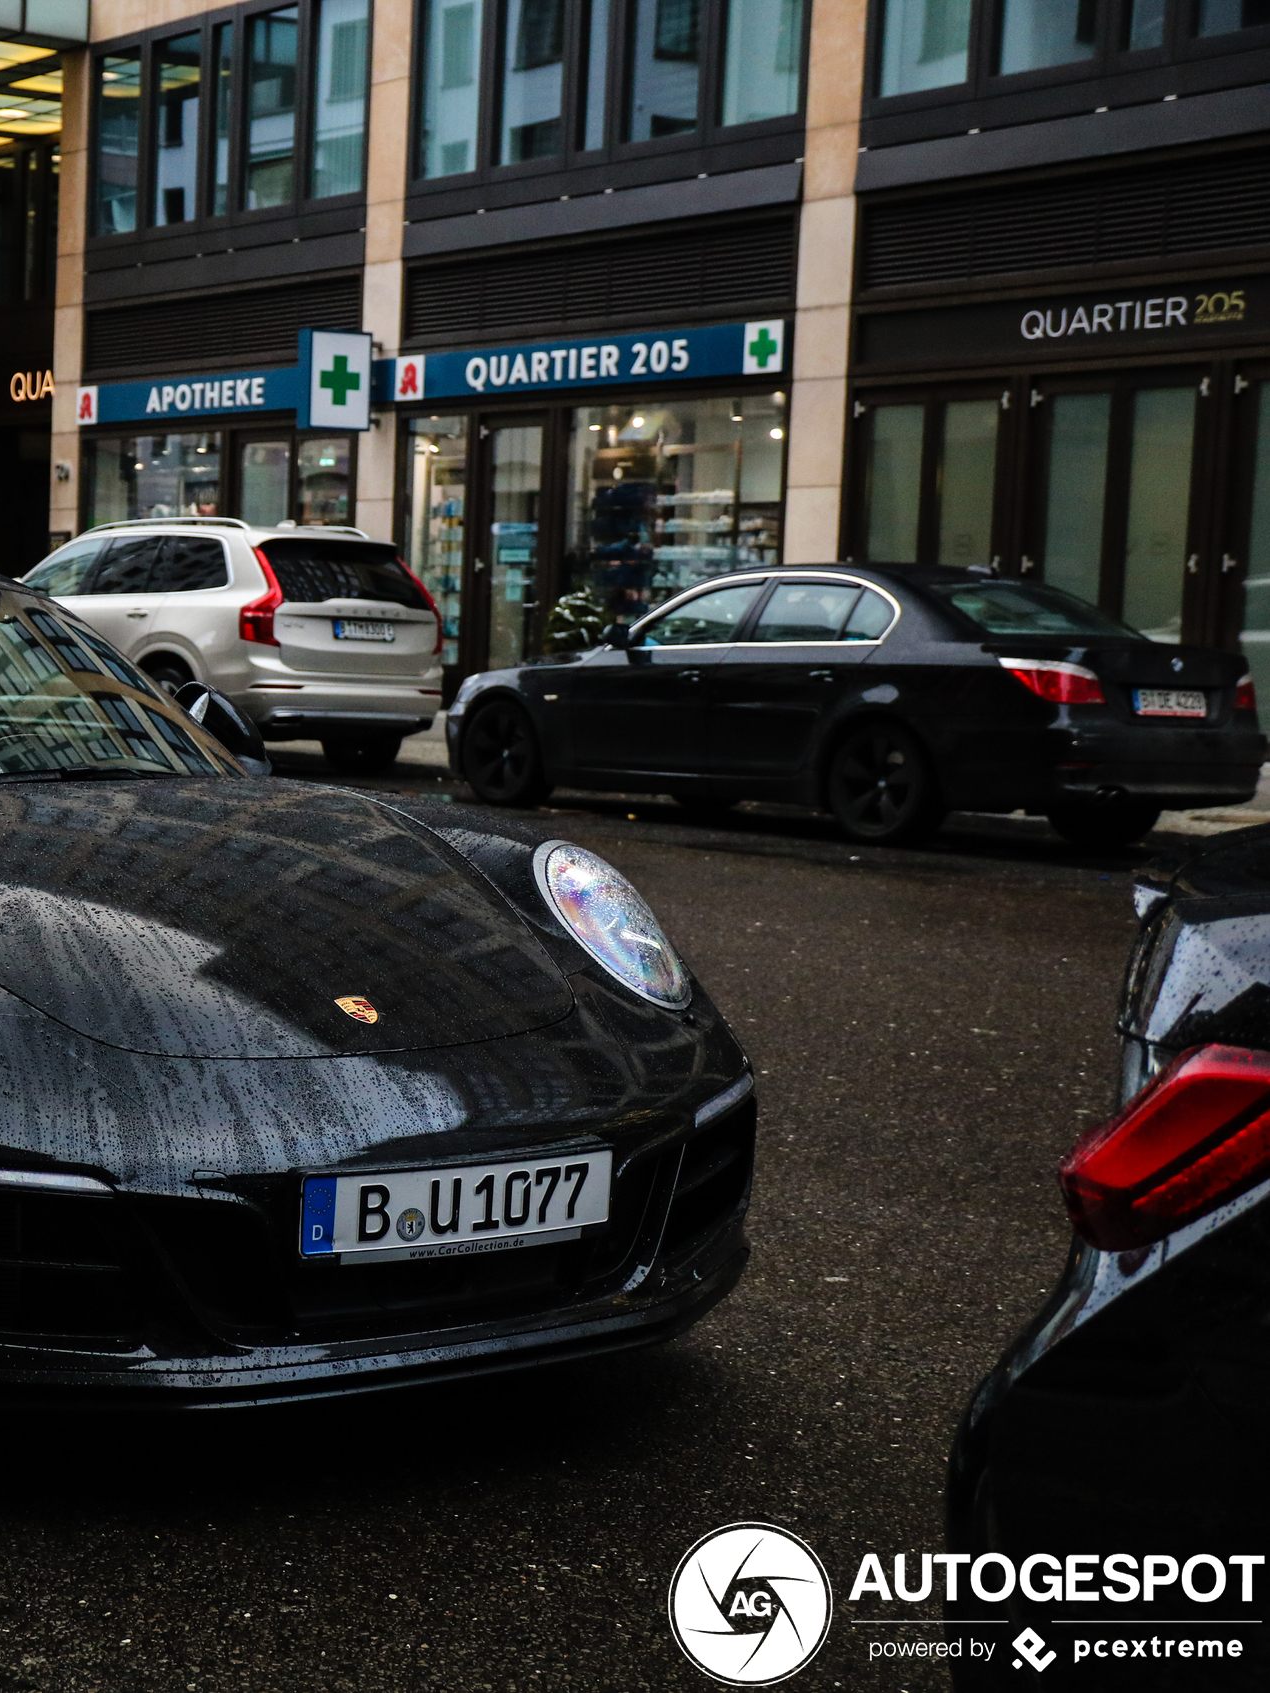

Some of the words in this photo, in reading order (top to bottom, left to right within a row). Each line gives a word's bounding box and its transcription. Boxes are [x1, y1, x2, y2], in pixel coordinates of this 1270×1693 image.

[1020, 296, 1188, 339] QUARTIER
[1194, 290, 1246, 316] 205
[465, 345, 619, 392] QUARTIER
[630, 338, 690, 376] 205
[146, 376, 266, 414] APOTHEKE
[312, 1225, 323, 1241] D
[357, 1183, 391, 1242] B
[409, 1238, 525, 1258] www.CarCollection.de
